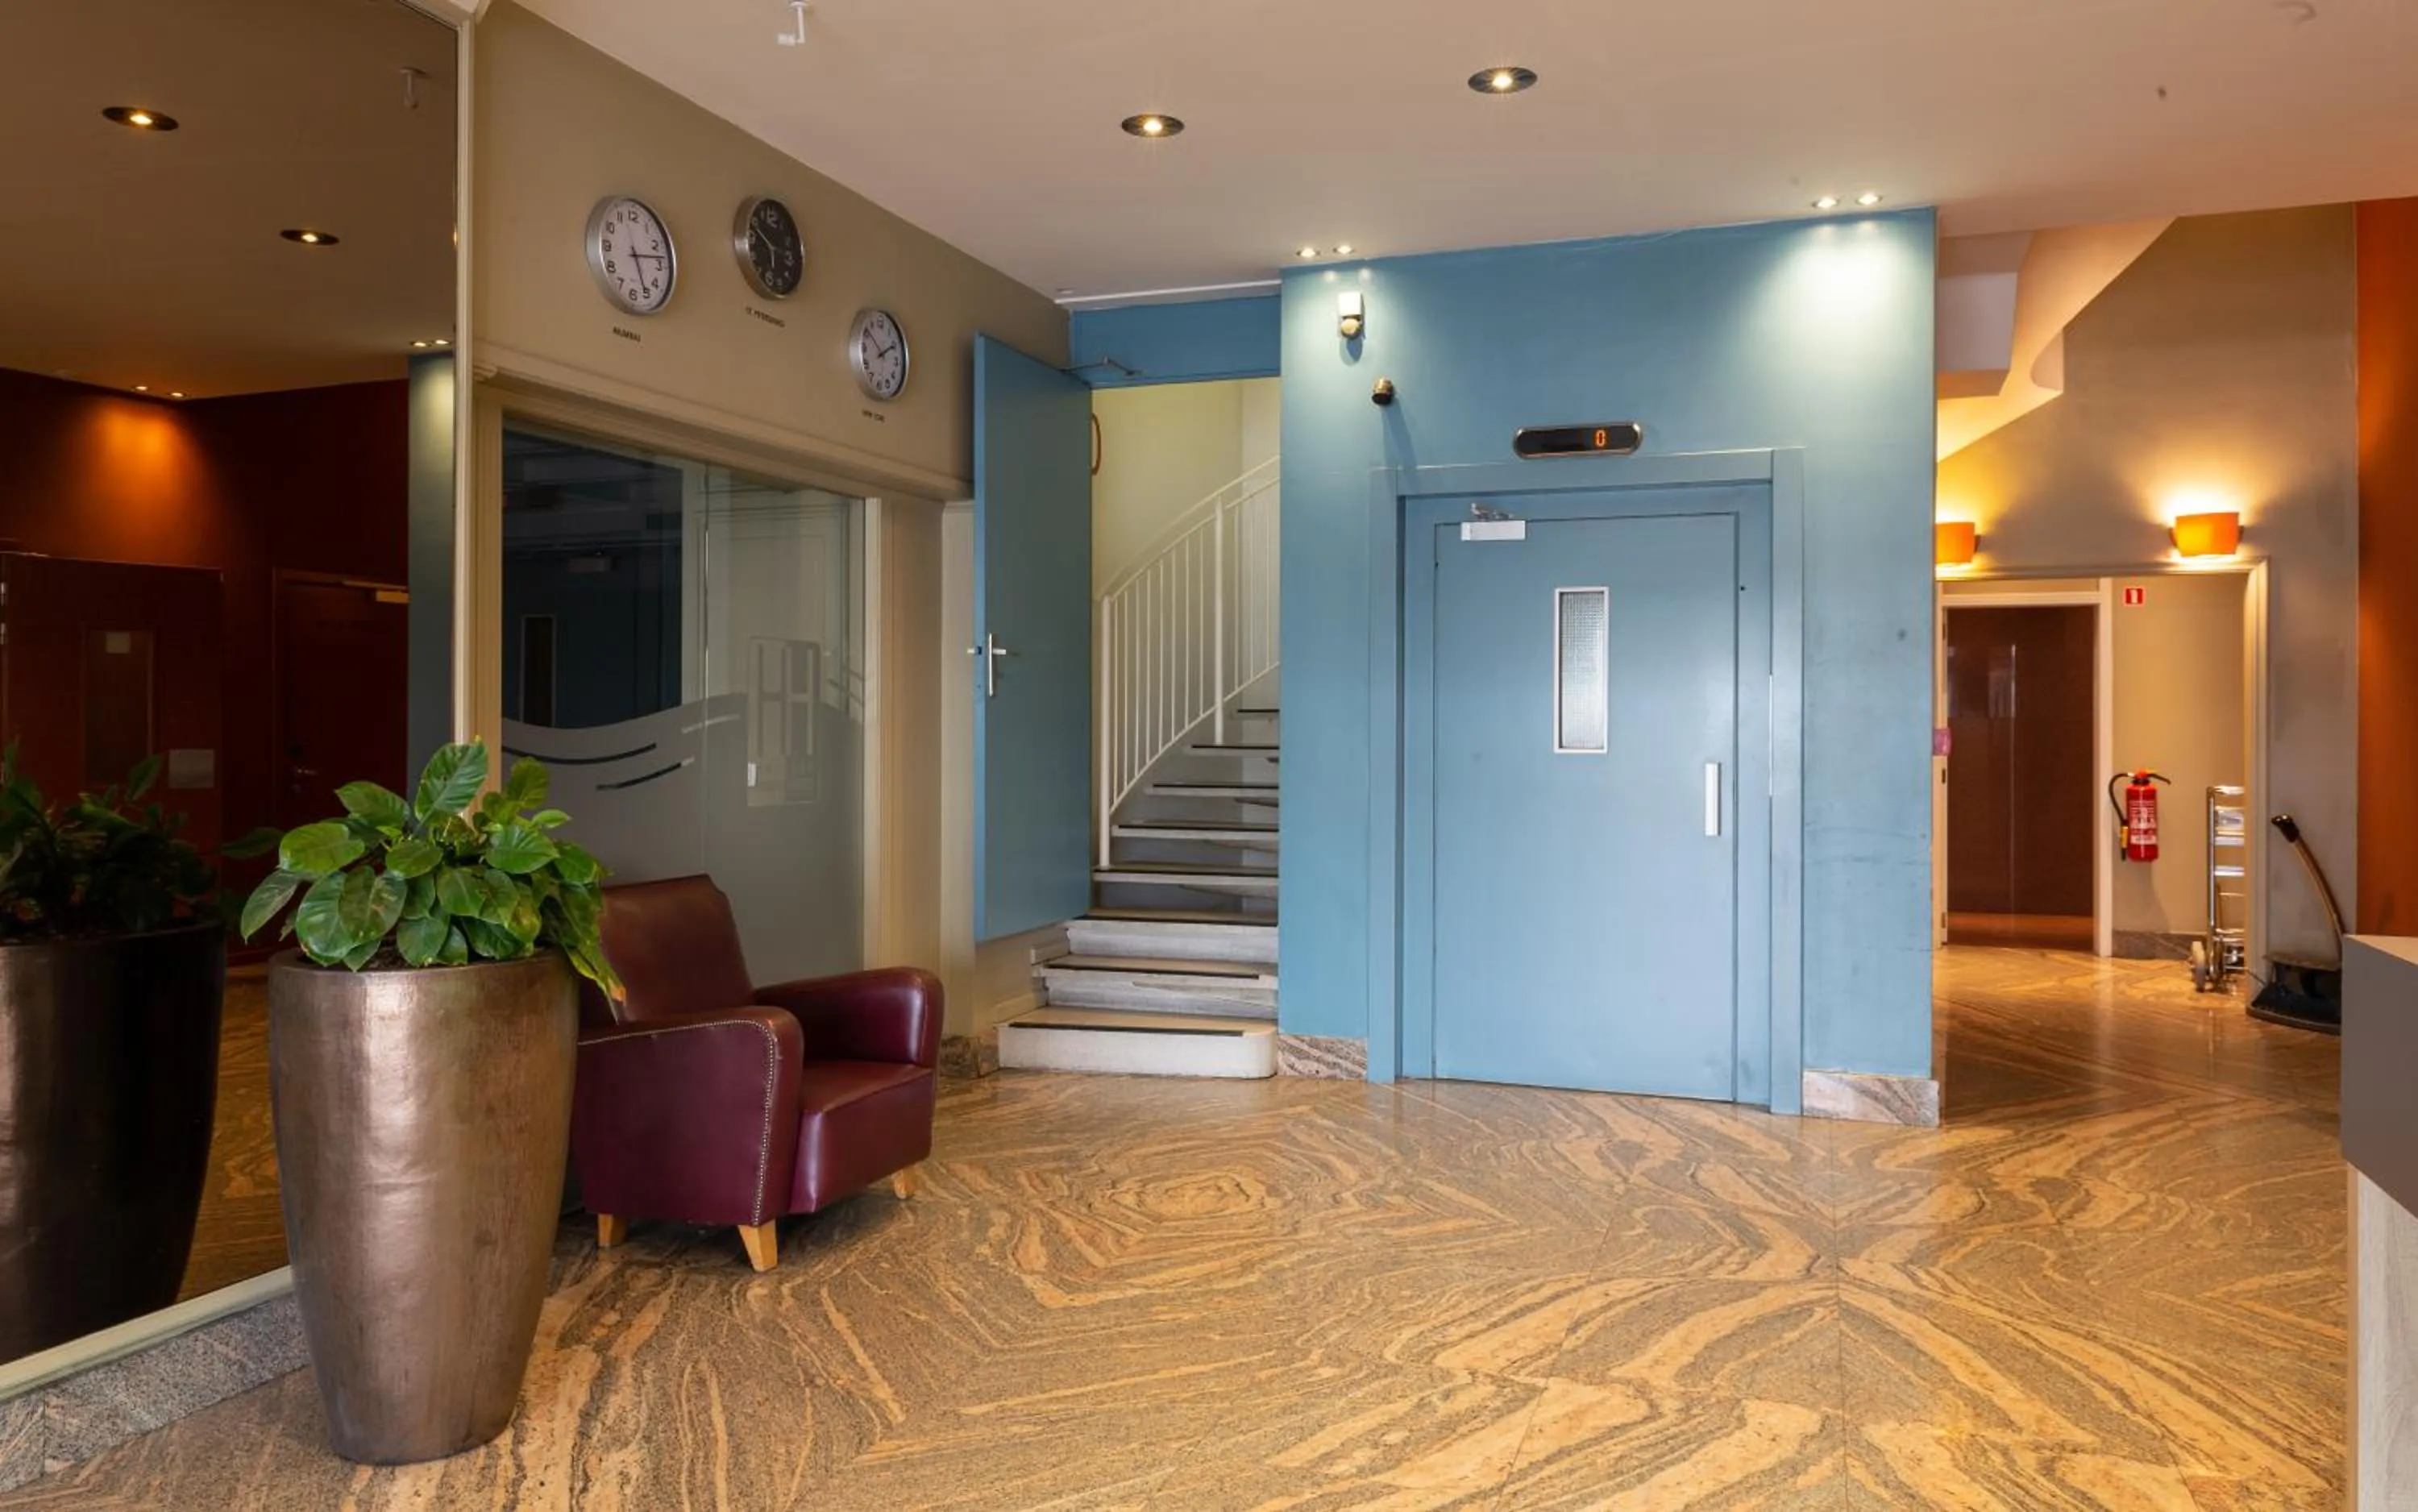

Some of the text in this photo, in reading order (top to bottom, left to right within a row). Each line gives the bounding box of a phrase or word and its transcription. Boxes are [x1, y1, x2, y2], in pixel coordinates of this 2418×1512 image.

[617, 211, 623, 224] 11
[628, 209, 639, 224] 12
[651, 239, 659, 252] 2
[606, 260, 617, 274] 8
[617, 276, 625, 291] 7
[651, 276, 659, 289] 4
[629, 288, 638, 301] 6
[1595, 429, 1606, 447] 0
